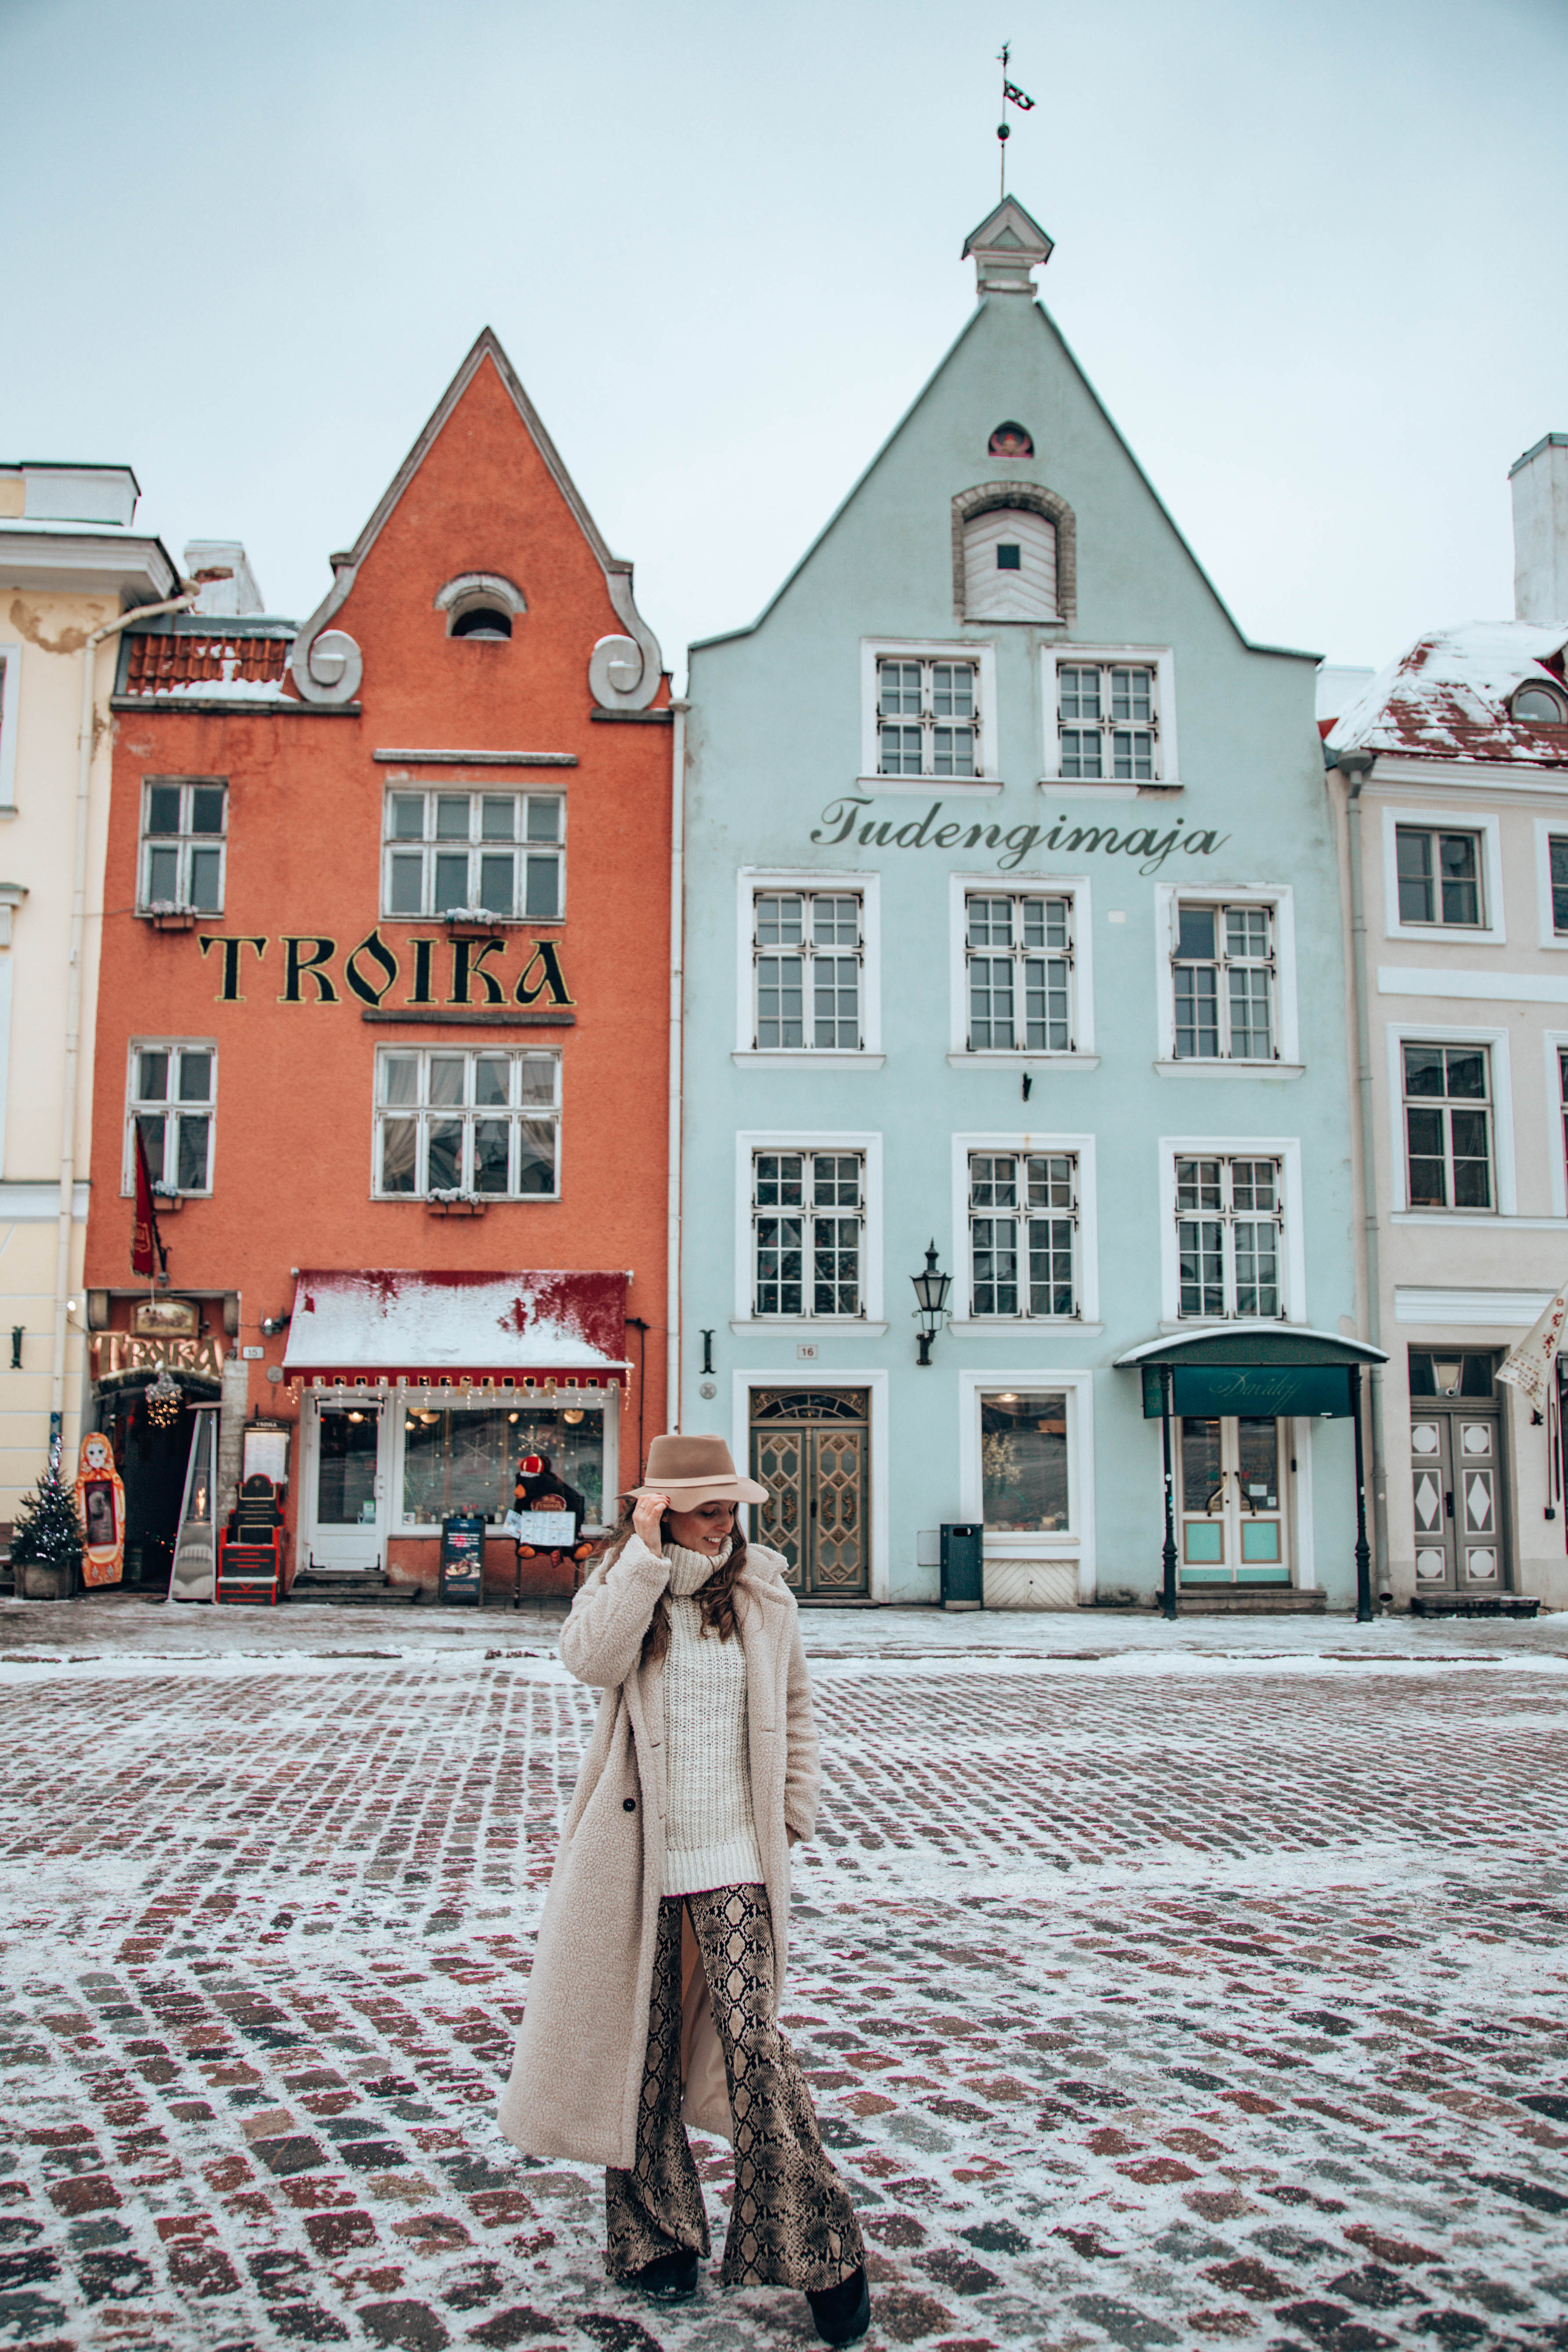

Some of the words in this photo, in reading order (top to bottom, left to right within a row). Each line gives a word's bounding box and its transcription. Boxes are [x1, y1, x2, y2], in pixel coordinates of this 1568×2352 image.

[810, 797, 1232, 876] Tudengimaja
[197, 925, 576, 1009] TROIKA
[802, 1348, 814, 1356] 16
